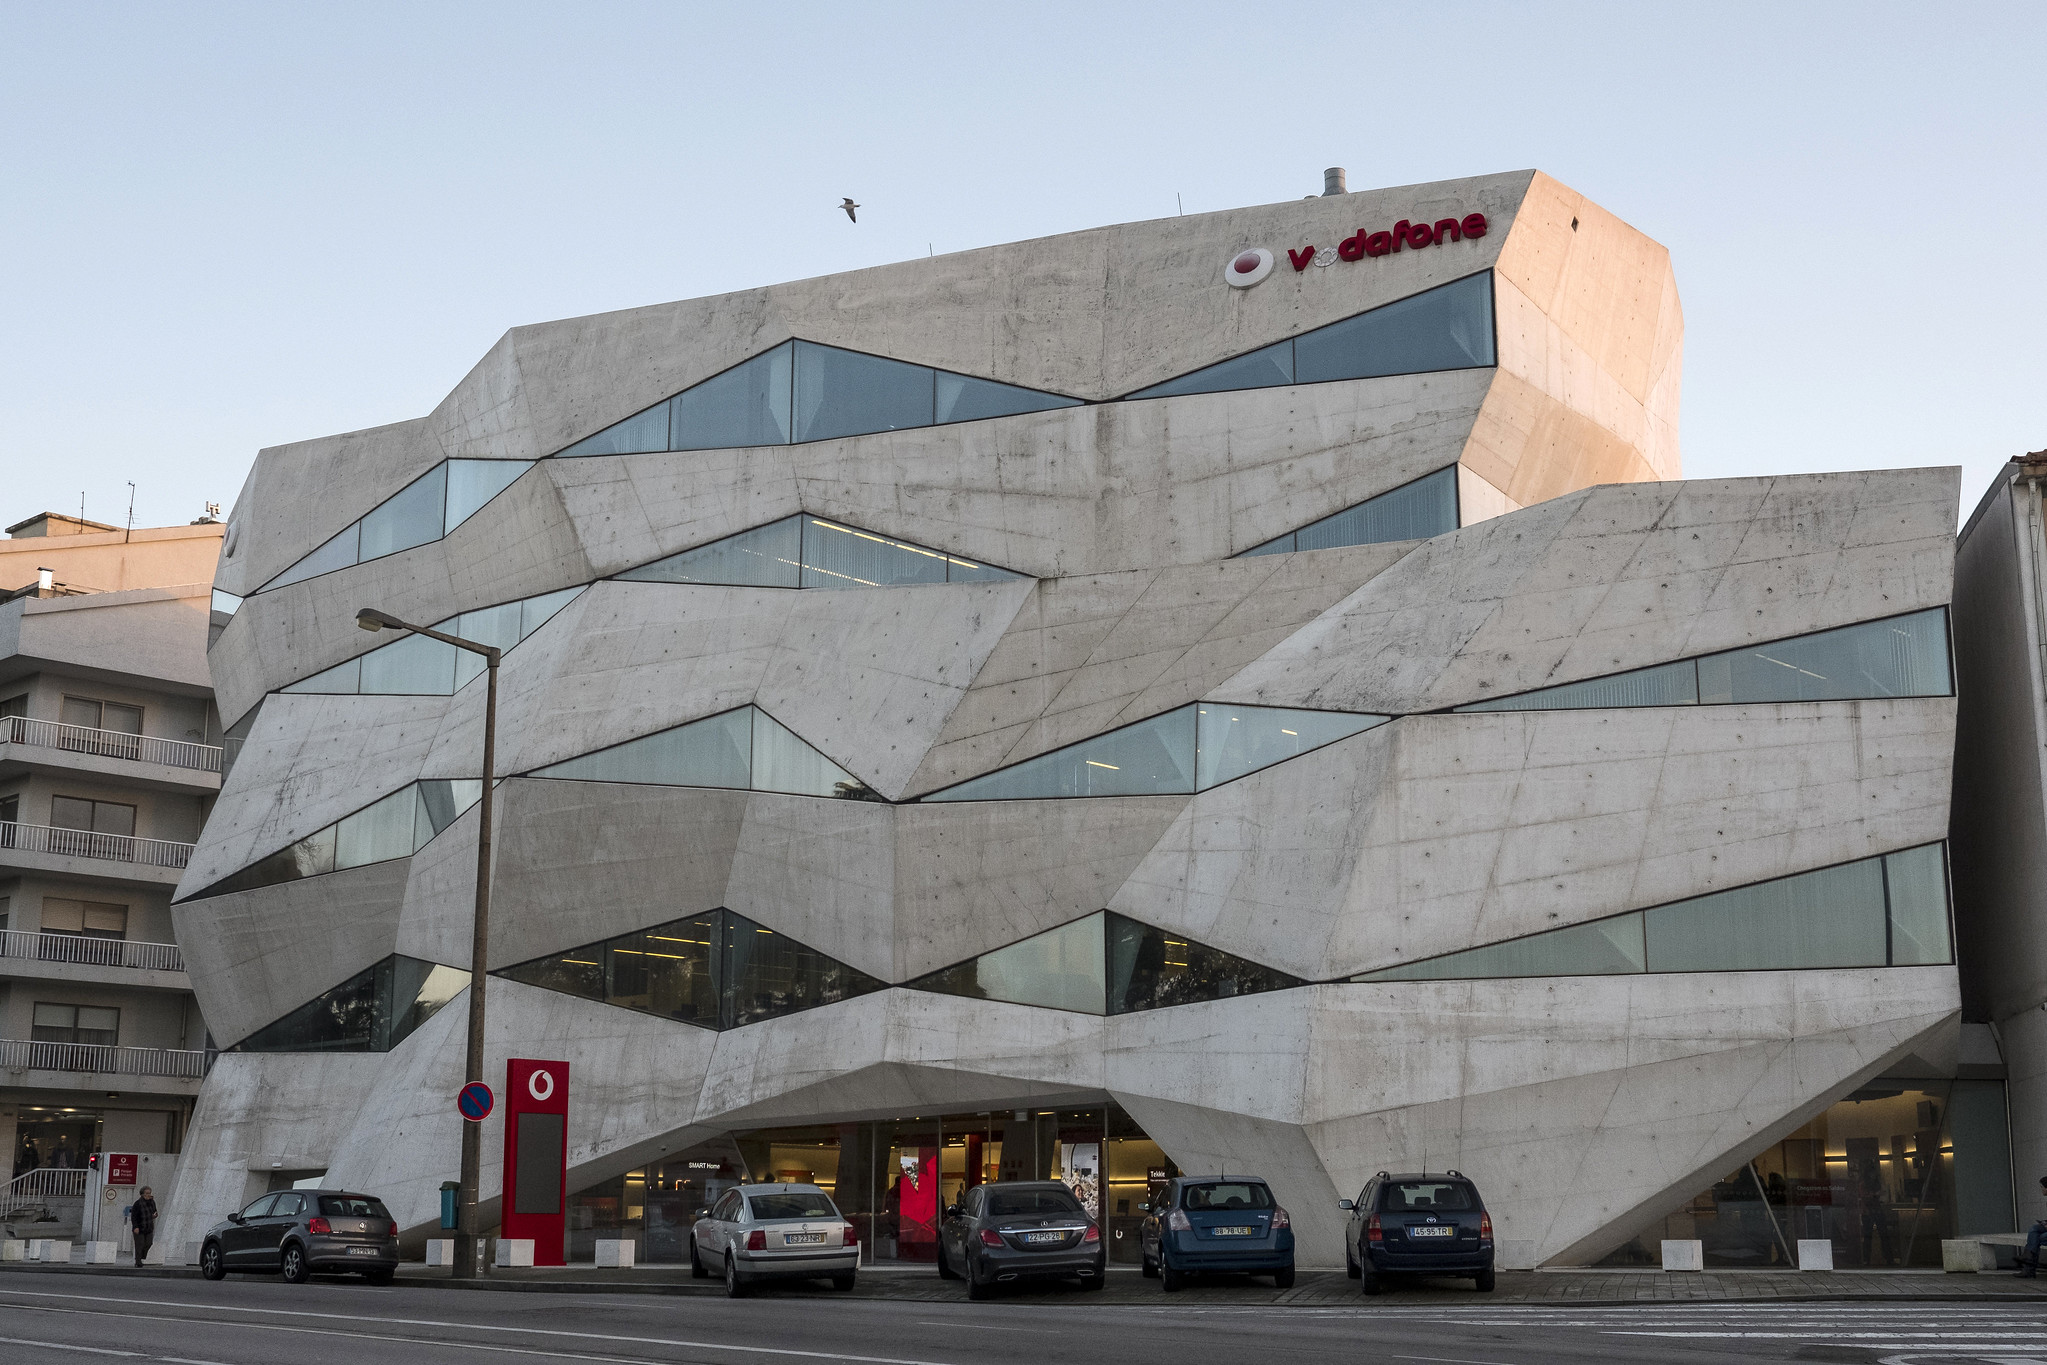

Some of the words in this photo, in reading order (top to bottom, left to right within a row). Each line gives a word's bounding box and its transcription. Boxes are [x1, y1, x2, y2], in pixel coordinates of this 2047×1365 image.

[1287, 212, 1488, 272] vodafone
[688, 1161, 706, 1169] SMART
[706, 1162, 721, 1170] Home
